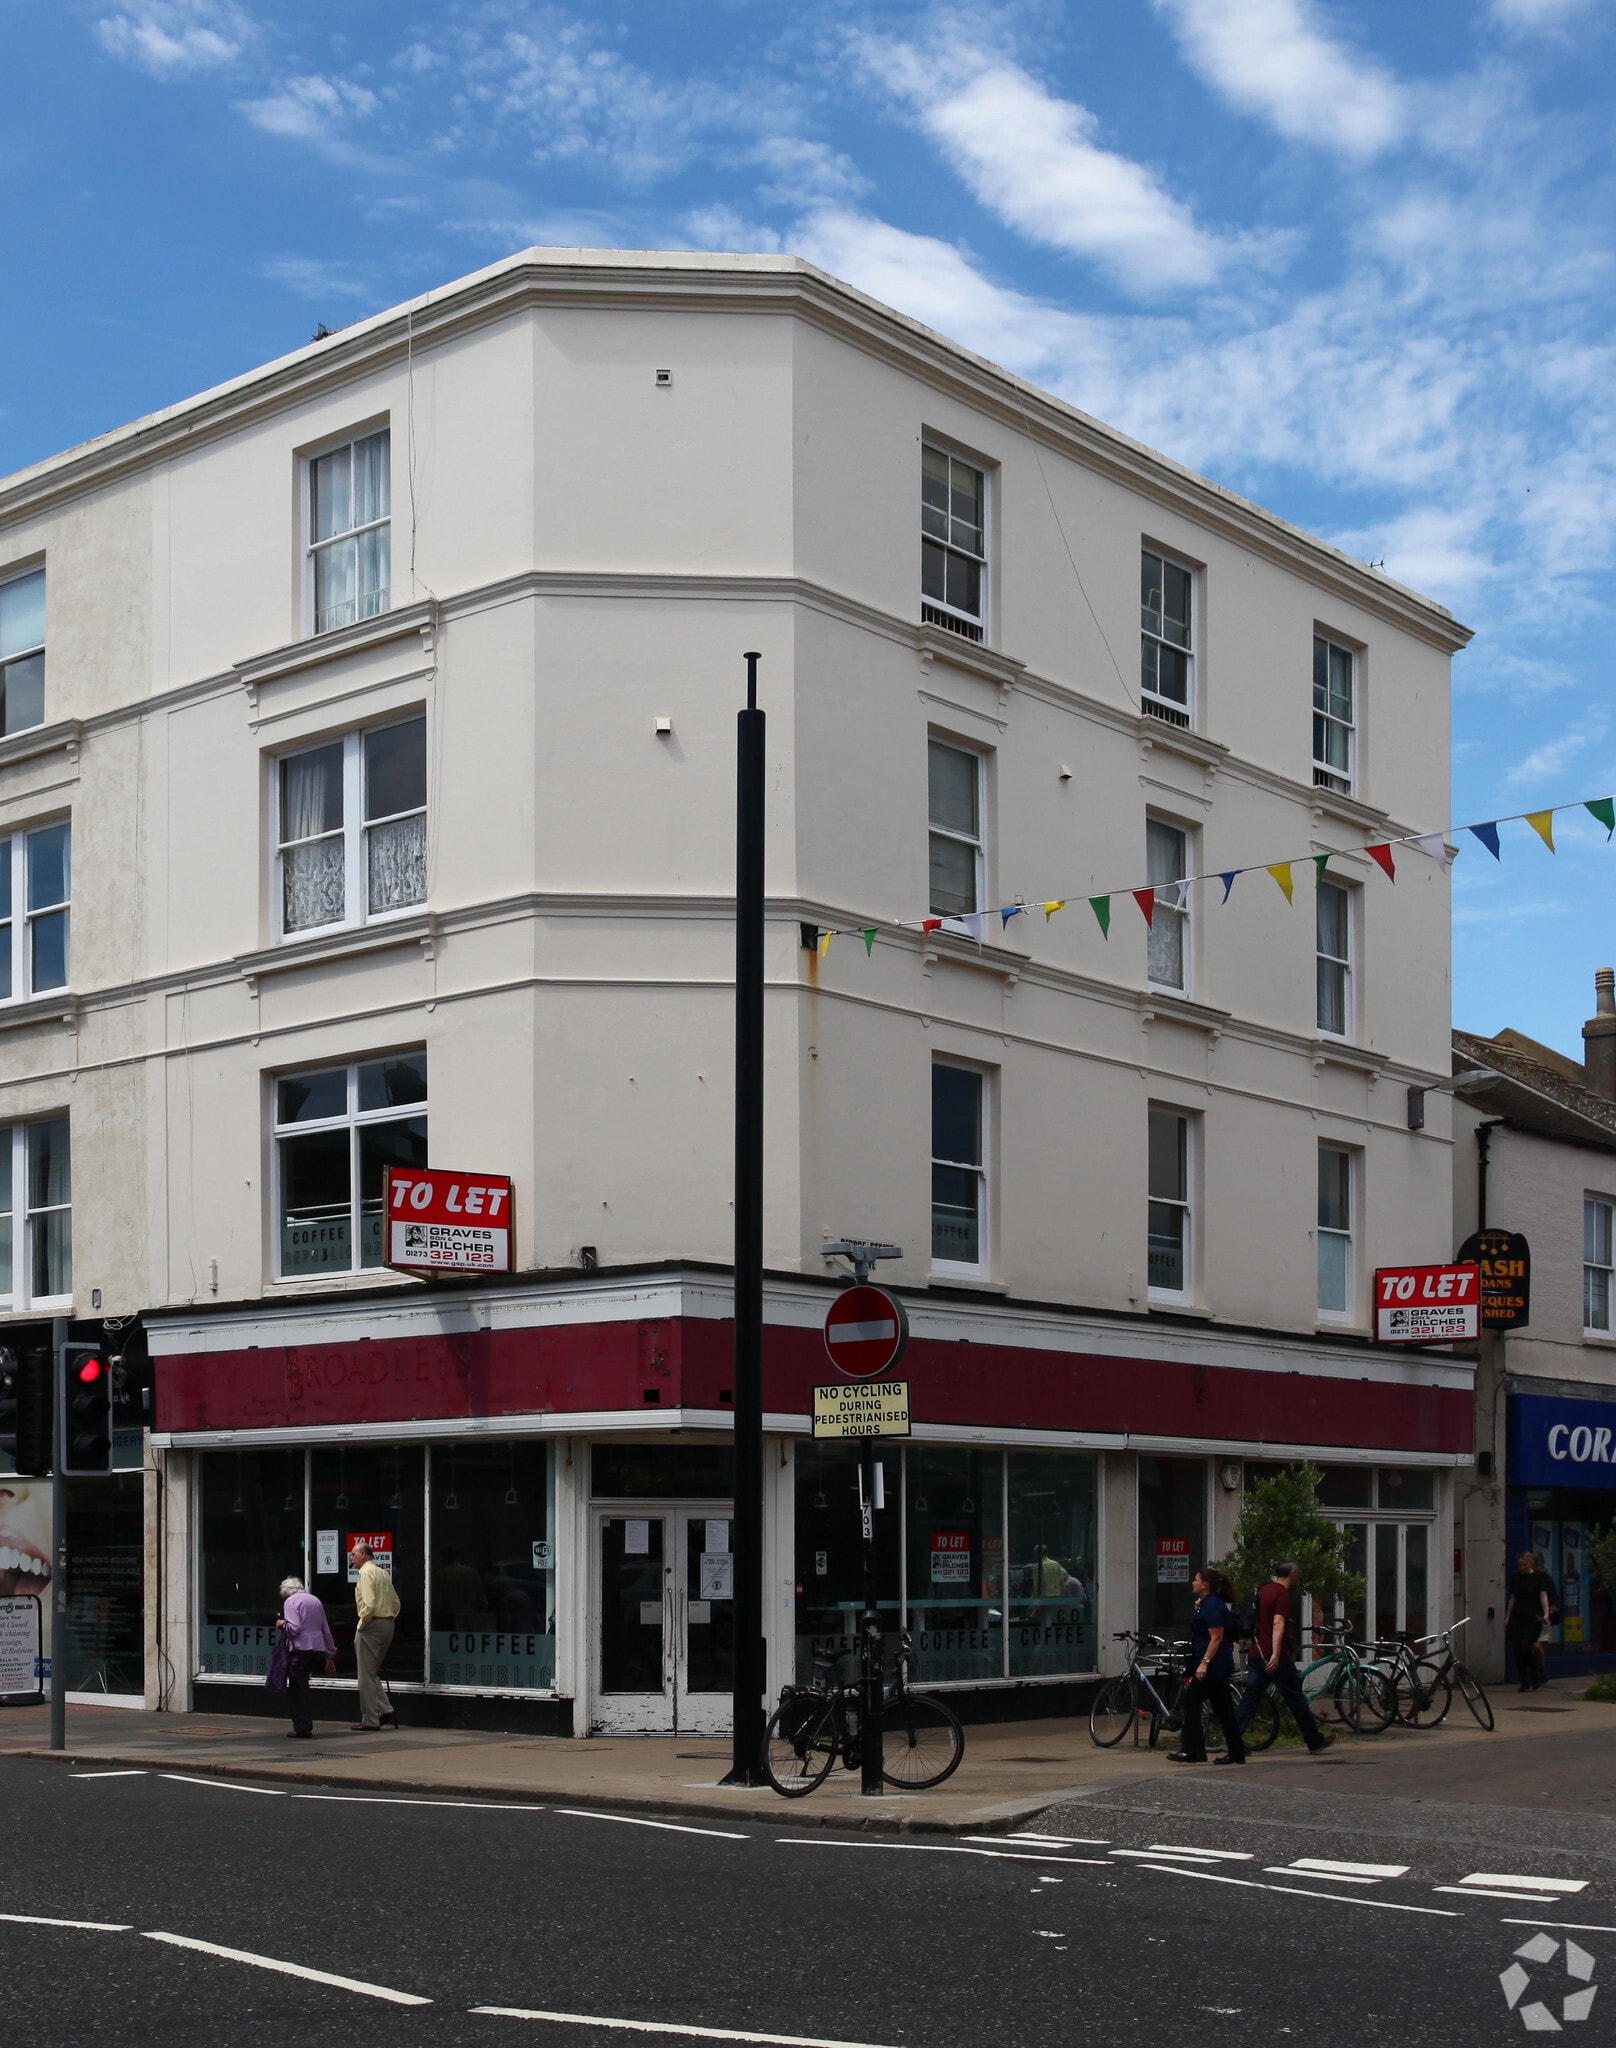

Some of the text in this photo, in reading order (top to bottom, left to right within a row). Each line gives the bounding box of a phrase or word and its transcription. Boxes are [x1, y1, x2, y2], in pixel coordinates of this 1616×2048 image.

[391, 1179, 509, 1216] TO LET
[292, 1226, 344, 1245] COFFEE
[429, 1227, 492, 1240] GRAVES
[429, 1240, 494, 1253] PILCHER
[405, 1250, 494, 1263] 01273 321 123
[1148, 1253, 1175, 1268] OFFEE
[1461, 1258, 1526, 1277] ASH
[1381, 1272, 1475, 1300] TO LET
[1481, 1278, 1512, 1288] OANS
[1481, 1296, 1525, 1307] EQUES
[1410, 1308, 1464, 1317] GRAVES
[1482, 1309, 1517, 1319] SHED
[1410, 1318, 1466, 1326] PILCHER
[1410, 1326, 1435, 1334] 321
[1441, 1325, 1466, 1333] 123
[819, 1383, 902, 1400] NO CYCLING
[839, 1399, 882, 1411] DURING
[815, 1411, 908, 1424] PEDESTRIANISED
[842, 1424, 881, 1435] HOURS
[1547, 1423, 1616, 1464] COR
[368, 1535, 386, 1549] LET
[937, 1536, 965, 1548] TO LET
[1162, 1541, 1185, 1552] TO LET
[216, 1626, 278, 1646] COFFE
[919, 1629, 989, 1651] COFFEE
[1020, 1626, 1085, 1646] COFFEE
[449, 1632, 537, 1656] COFFEE
[204, 1653, 269, 1675] REPUB
[434, 1662, 552, 1689] REPUBLIC
